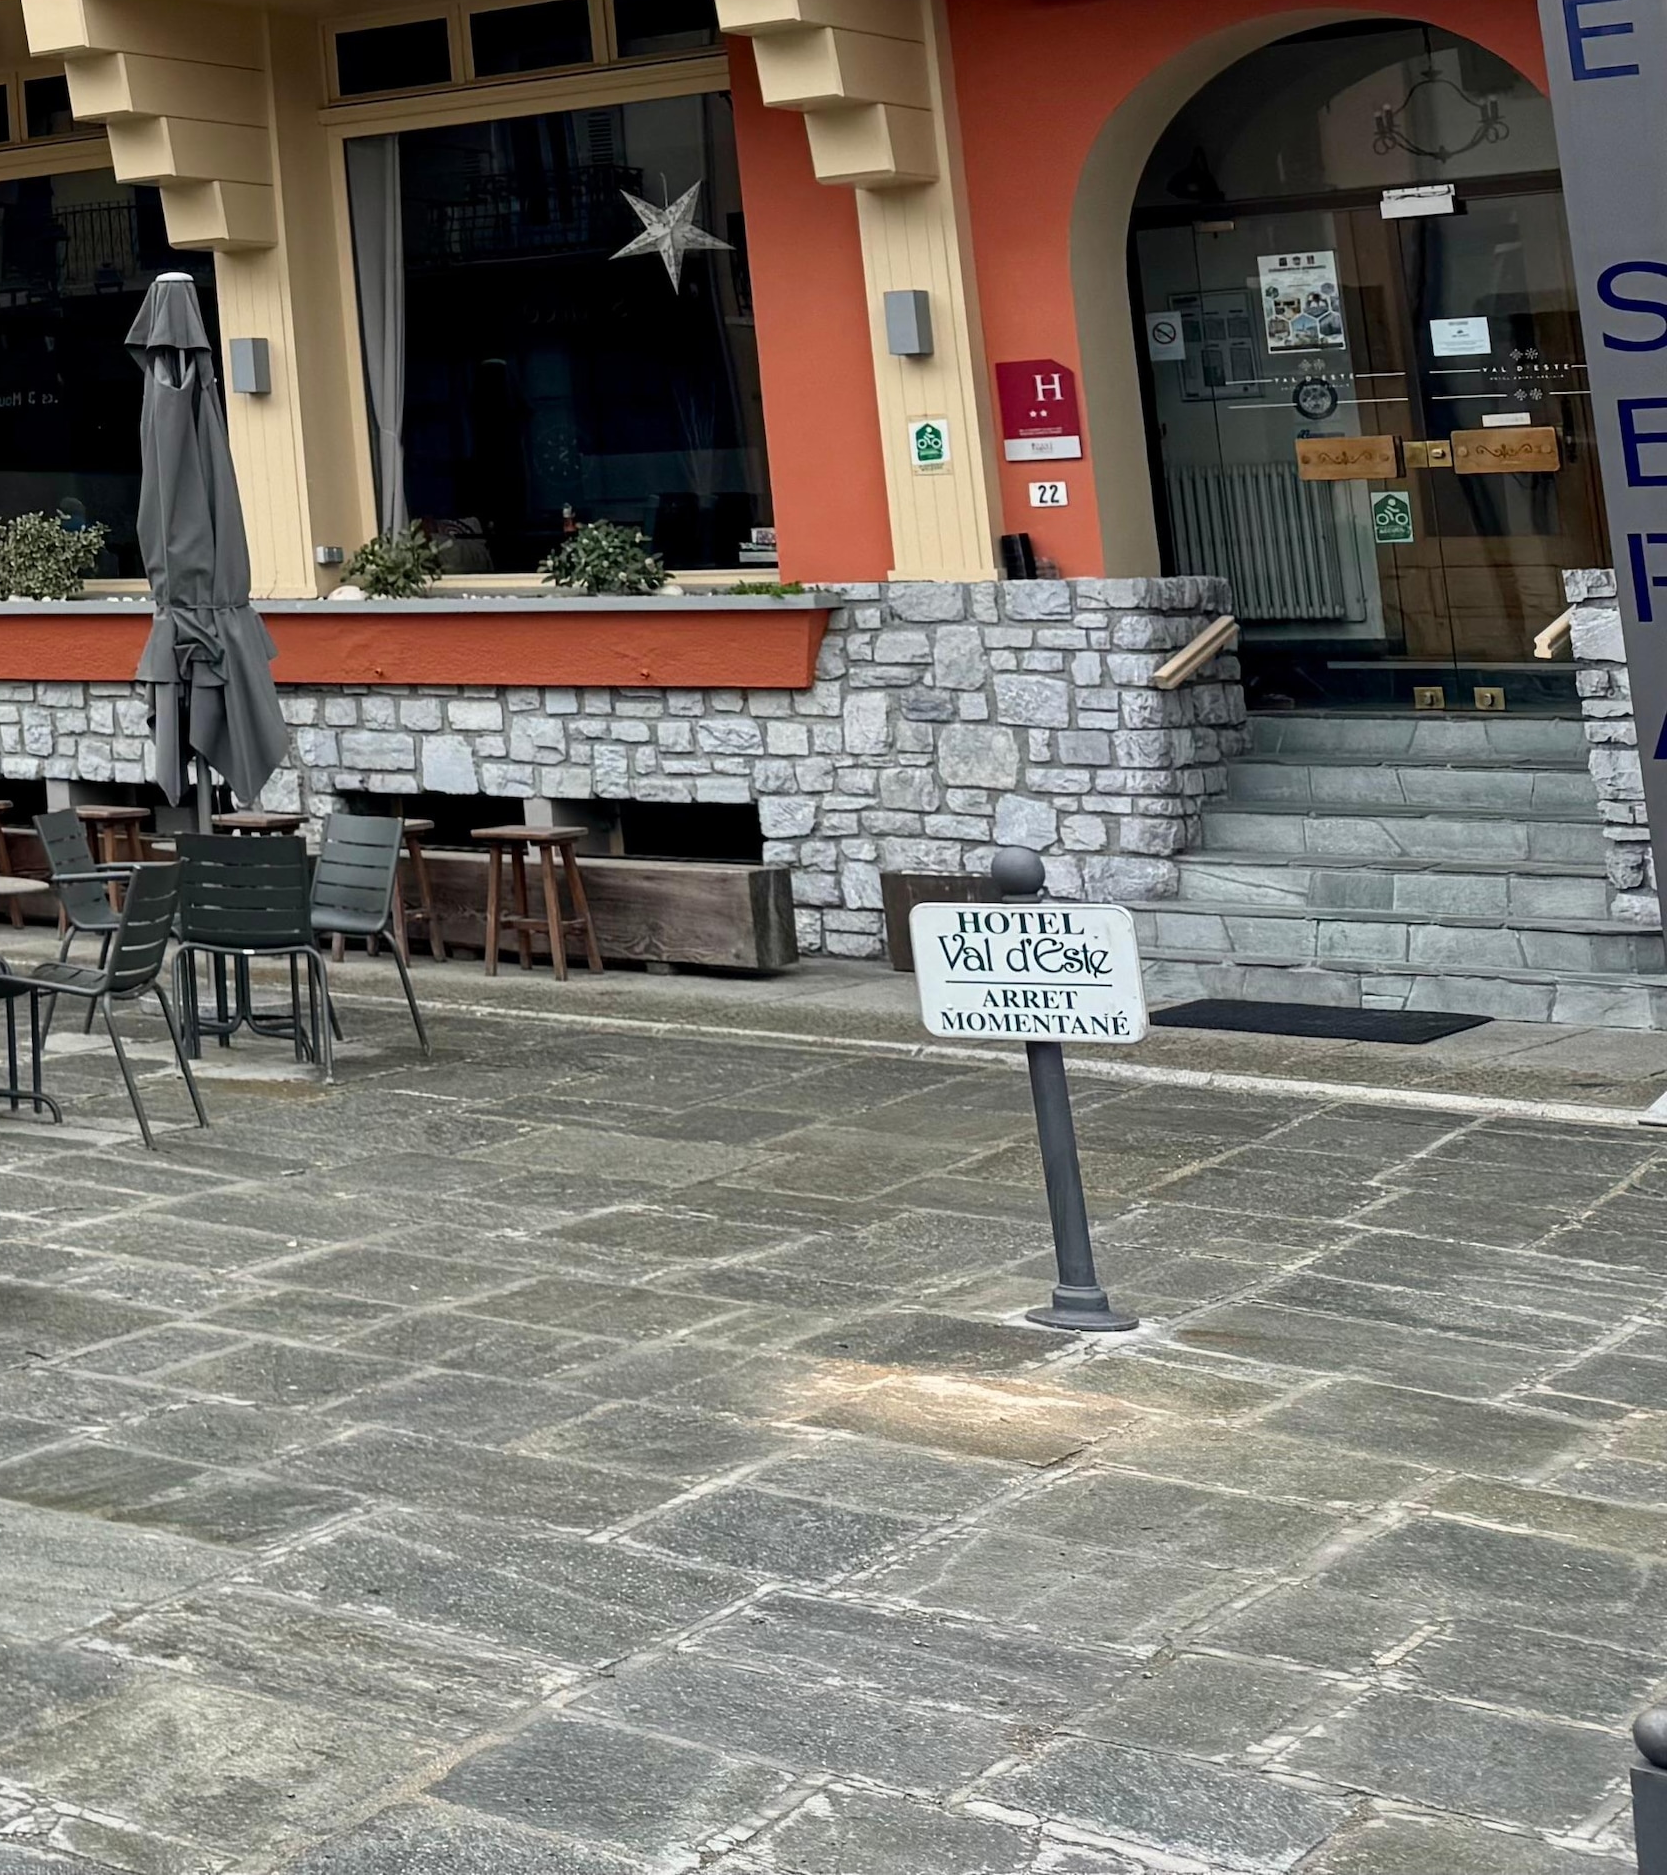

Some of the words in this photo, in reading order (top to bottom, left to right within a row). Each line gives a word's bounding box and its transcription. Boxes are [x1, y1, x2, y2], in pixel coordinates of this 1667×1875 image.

[1034, 373, 1065, 401] H
[1037, 484, 1060, 504] 22
[956, 911, 1085, 935] HOTEL
[937, 933, 994, 972] Val
[1006, 937, 1113, 978] d'Este
[982, 989, 1079, 1010] ARRET
[940, 1010, 1131, 1037] MOMENTANÉ
